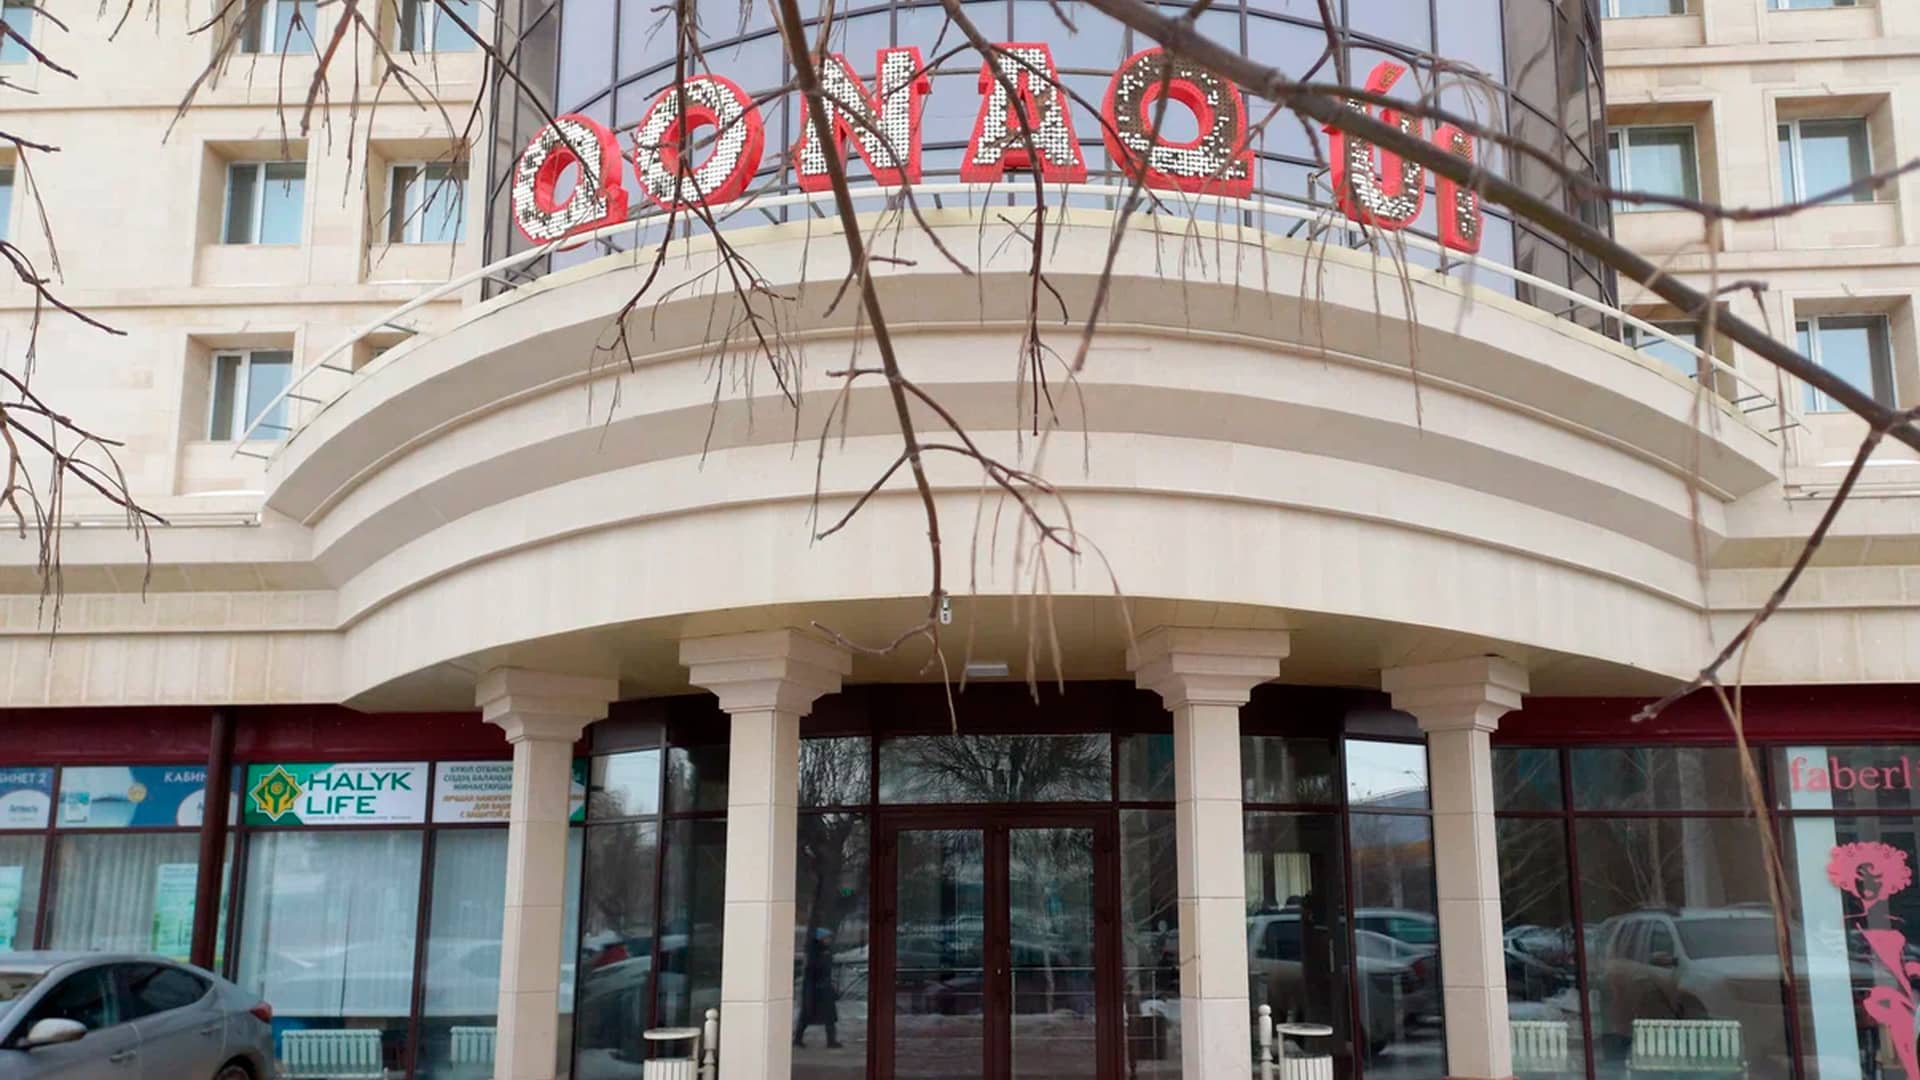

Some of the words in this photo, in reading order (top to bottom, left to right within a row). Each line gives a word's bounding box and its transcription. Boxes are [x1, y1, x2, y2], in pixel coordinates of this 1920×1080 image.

[512, 42, 1255, 245] QONAQ
[308, 772, 412, 791] HALYK
[306, 796, 377, 815] LIFE
